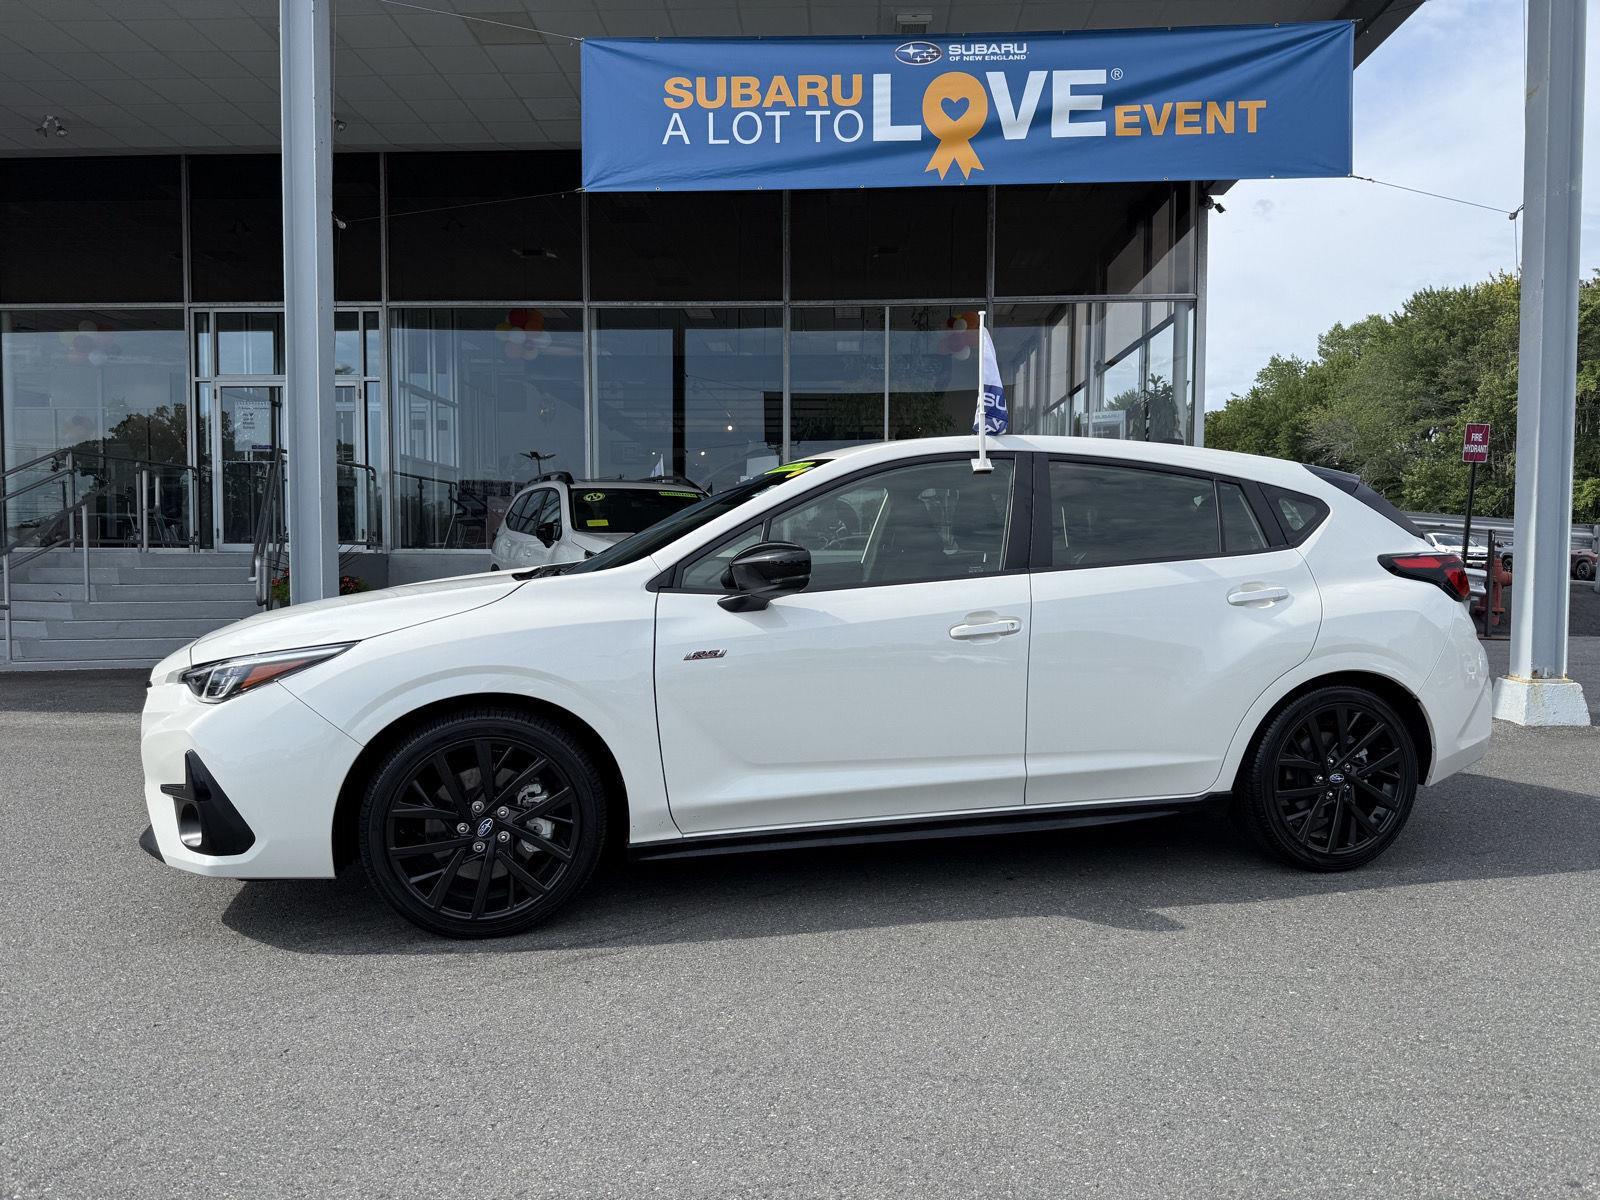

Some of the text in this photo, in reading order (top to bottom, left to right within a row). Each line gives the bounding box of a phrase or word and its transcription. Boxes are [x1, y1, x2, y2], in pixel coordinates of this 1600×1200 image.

[948, 43, 1027, 55] SUBARU
[663, 74, 863, 109] SUBARU
[662, 109, 864, 145] A LOT TO
[1114, 100, 1267, 137] EVENT
[1464, 444, 1488, 453] HYDRANT
[1471, 433, 1483, 442] FIRE
